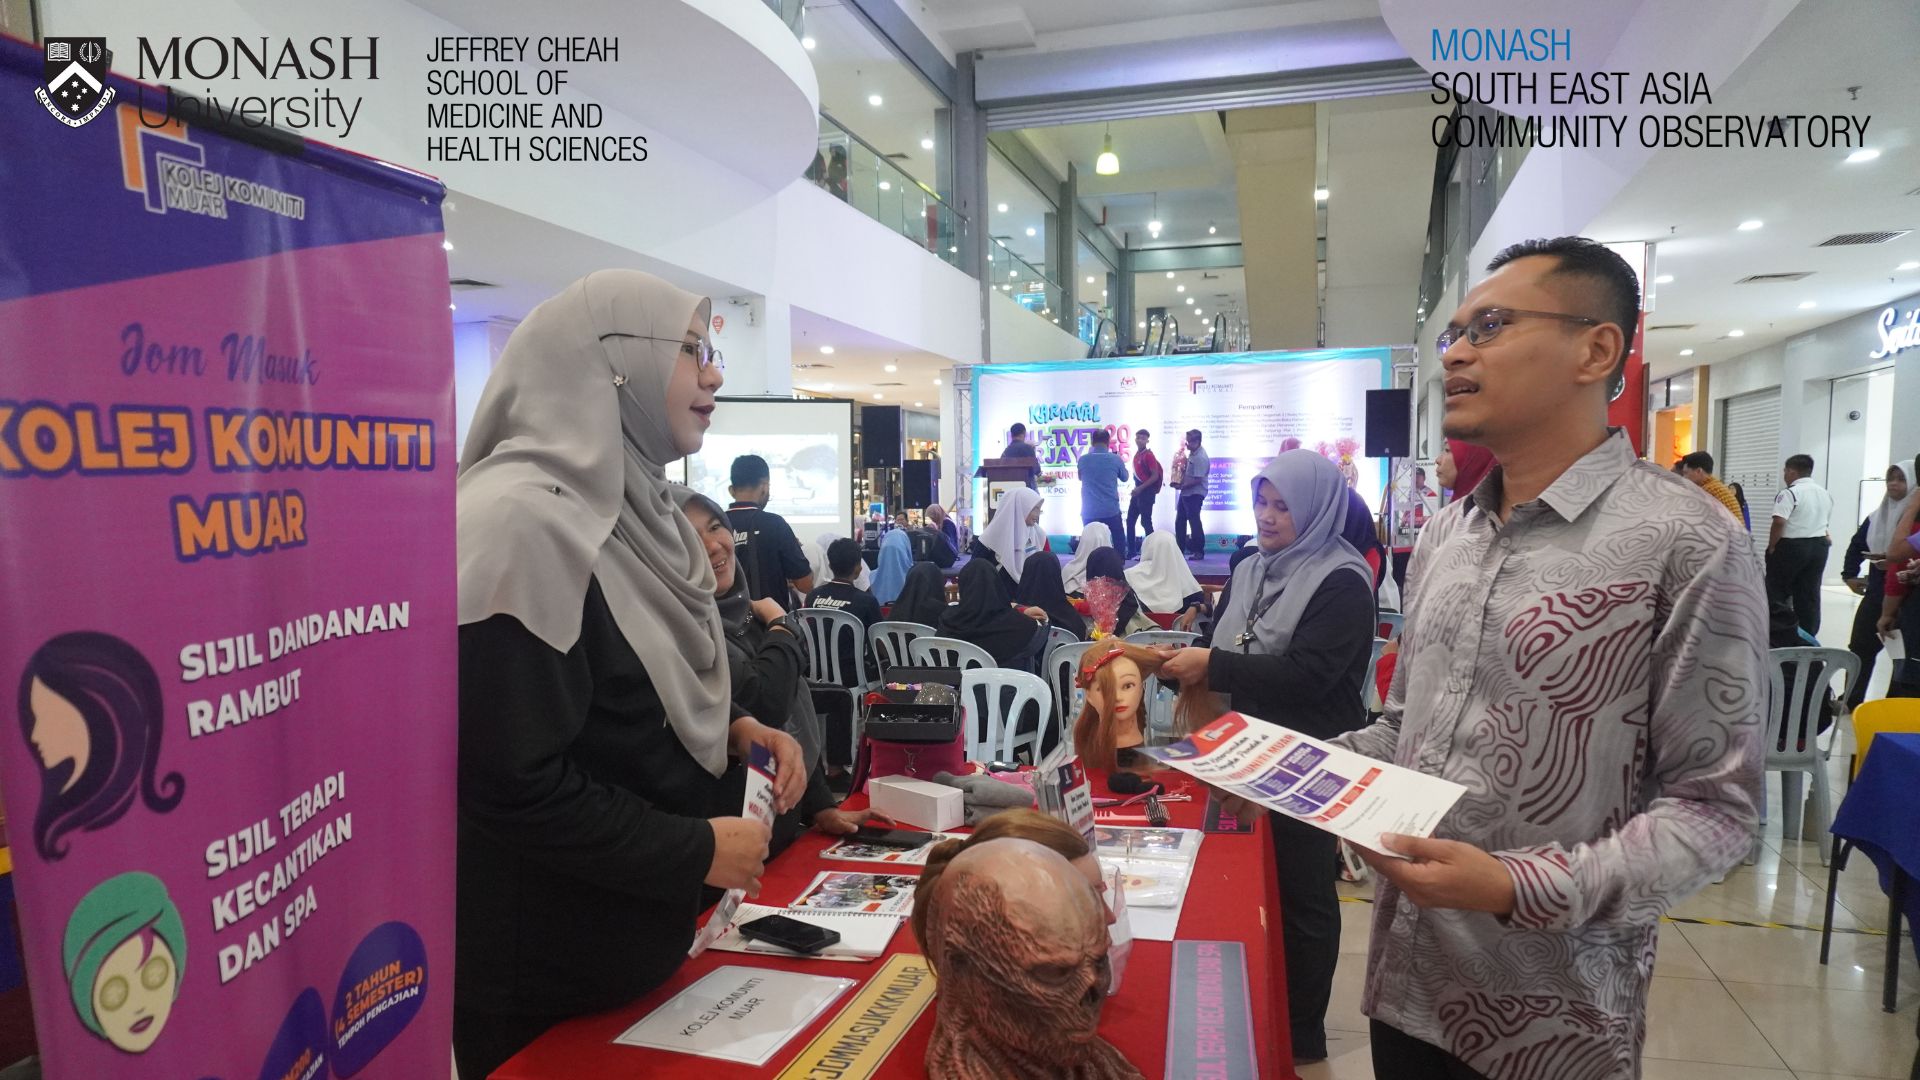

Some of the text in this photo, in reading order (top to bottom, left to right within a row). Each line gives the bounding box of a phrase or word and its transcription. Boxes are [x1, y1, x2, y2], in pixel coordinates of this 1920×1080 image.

[162, 161, 305, 220] KOLEJ KOMUNITI
[166, 186, 228, 219] MUAR
[121, 322, 320, 385] Jom Masuk
[208, 413, 432, 467] KOMUNITI
[1029, 401, 1101, 424] KARNIVAL
[176, 495, 305, 557] MUAR
[180, 601, 410, 682] SIJIL DANDANAN
[187, 668, 302, 738] RAMBUT
[205, 771, 345, 878] SIJIL TERAPI
[212, 812, 352, 932] KECANTIKAN
[218, 885, 318, 984] DAN SPA
[347, 966, 424, 1026] SEMESTER)
[354, 960, 401, 999] TAHUN
[680, 977, 764, 1036] KOLEJ KOMUNITI
[728, 997, 765, 1020] MUAR
[337, 986, 419, 1049] TEMPOH PENGAJIAN
[805, 966, 929, 1080] JOMMASUKKKMUAR
